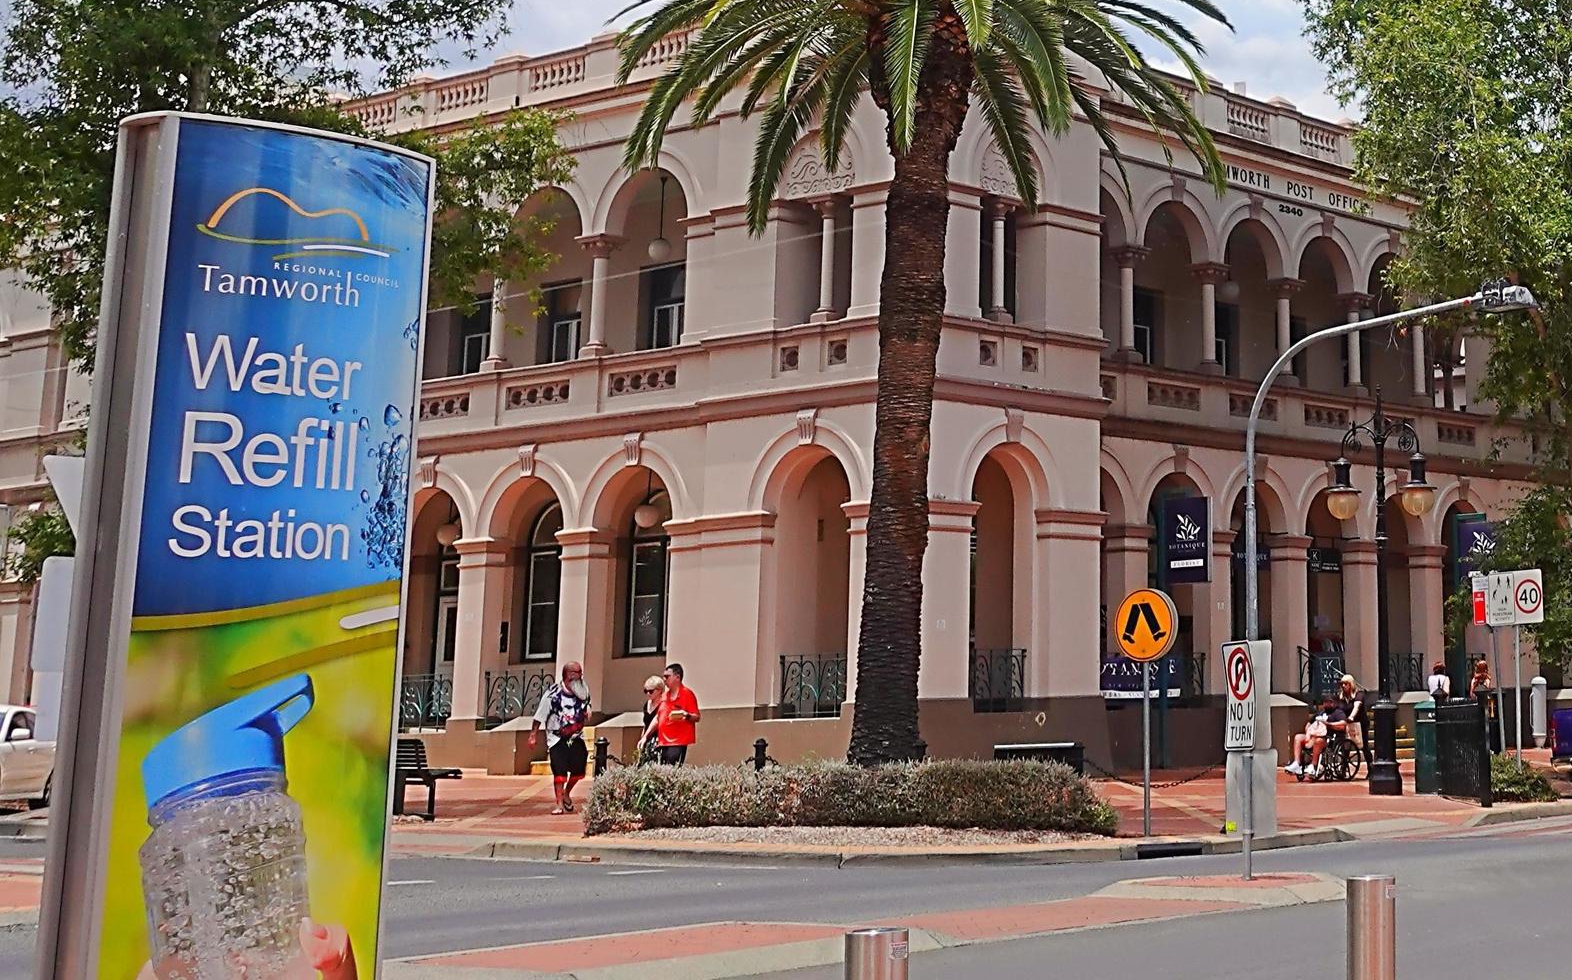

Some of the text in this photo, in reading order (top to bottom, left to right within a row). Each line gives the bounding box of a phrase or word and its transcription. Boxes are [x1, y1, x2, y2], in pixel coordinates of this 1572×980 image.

[1278, 203, 1303, 217] 2340
[1287, 181, 1314, 201] POST
[1328, 192, 1364, 215] OFFIC
[198, 264, 359, 308] Tamworth
[274, 262, 399, 289] REGIONAL COUNCIL
[185, 332, 362, 400] Water
[178, 411, 358, 491] Refill
[168, 504, 349, 561] Station
[1519, 588, 1538, 604] 40
[1230, 702, 1254, 721] NO U
[1230, 726, 1252, 741] TURN
